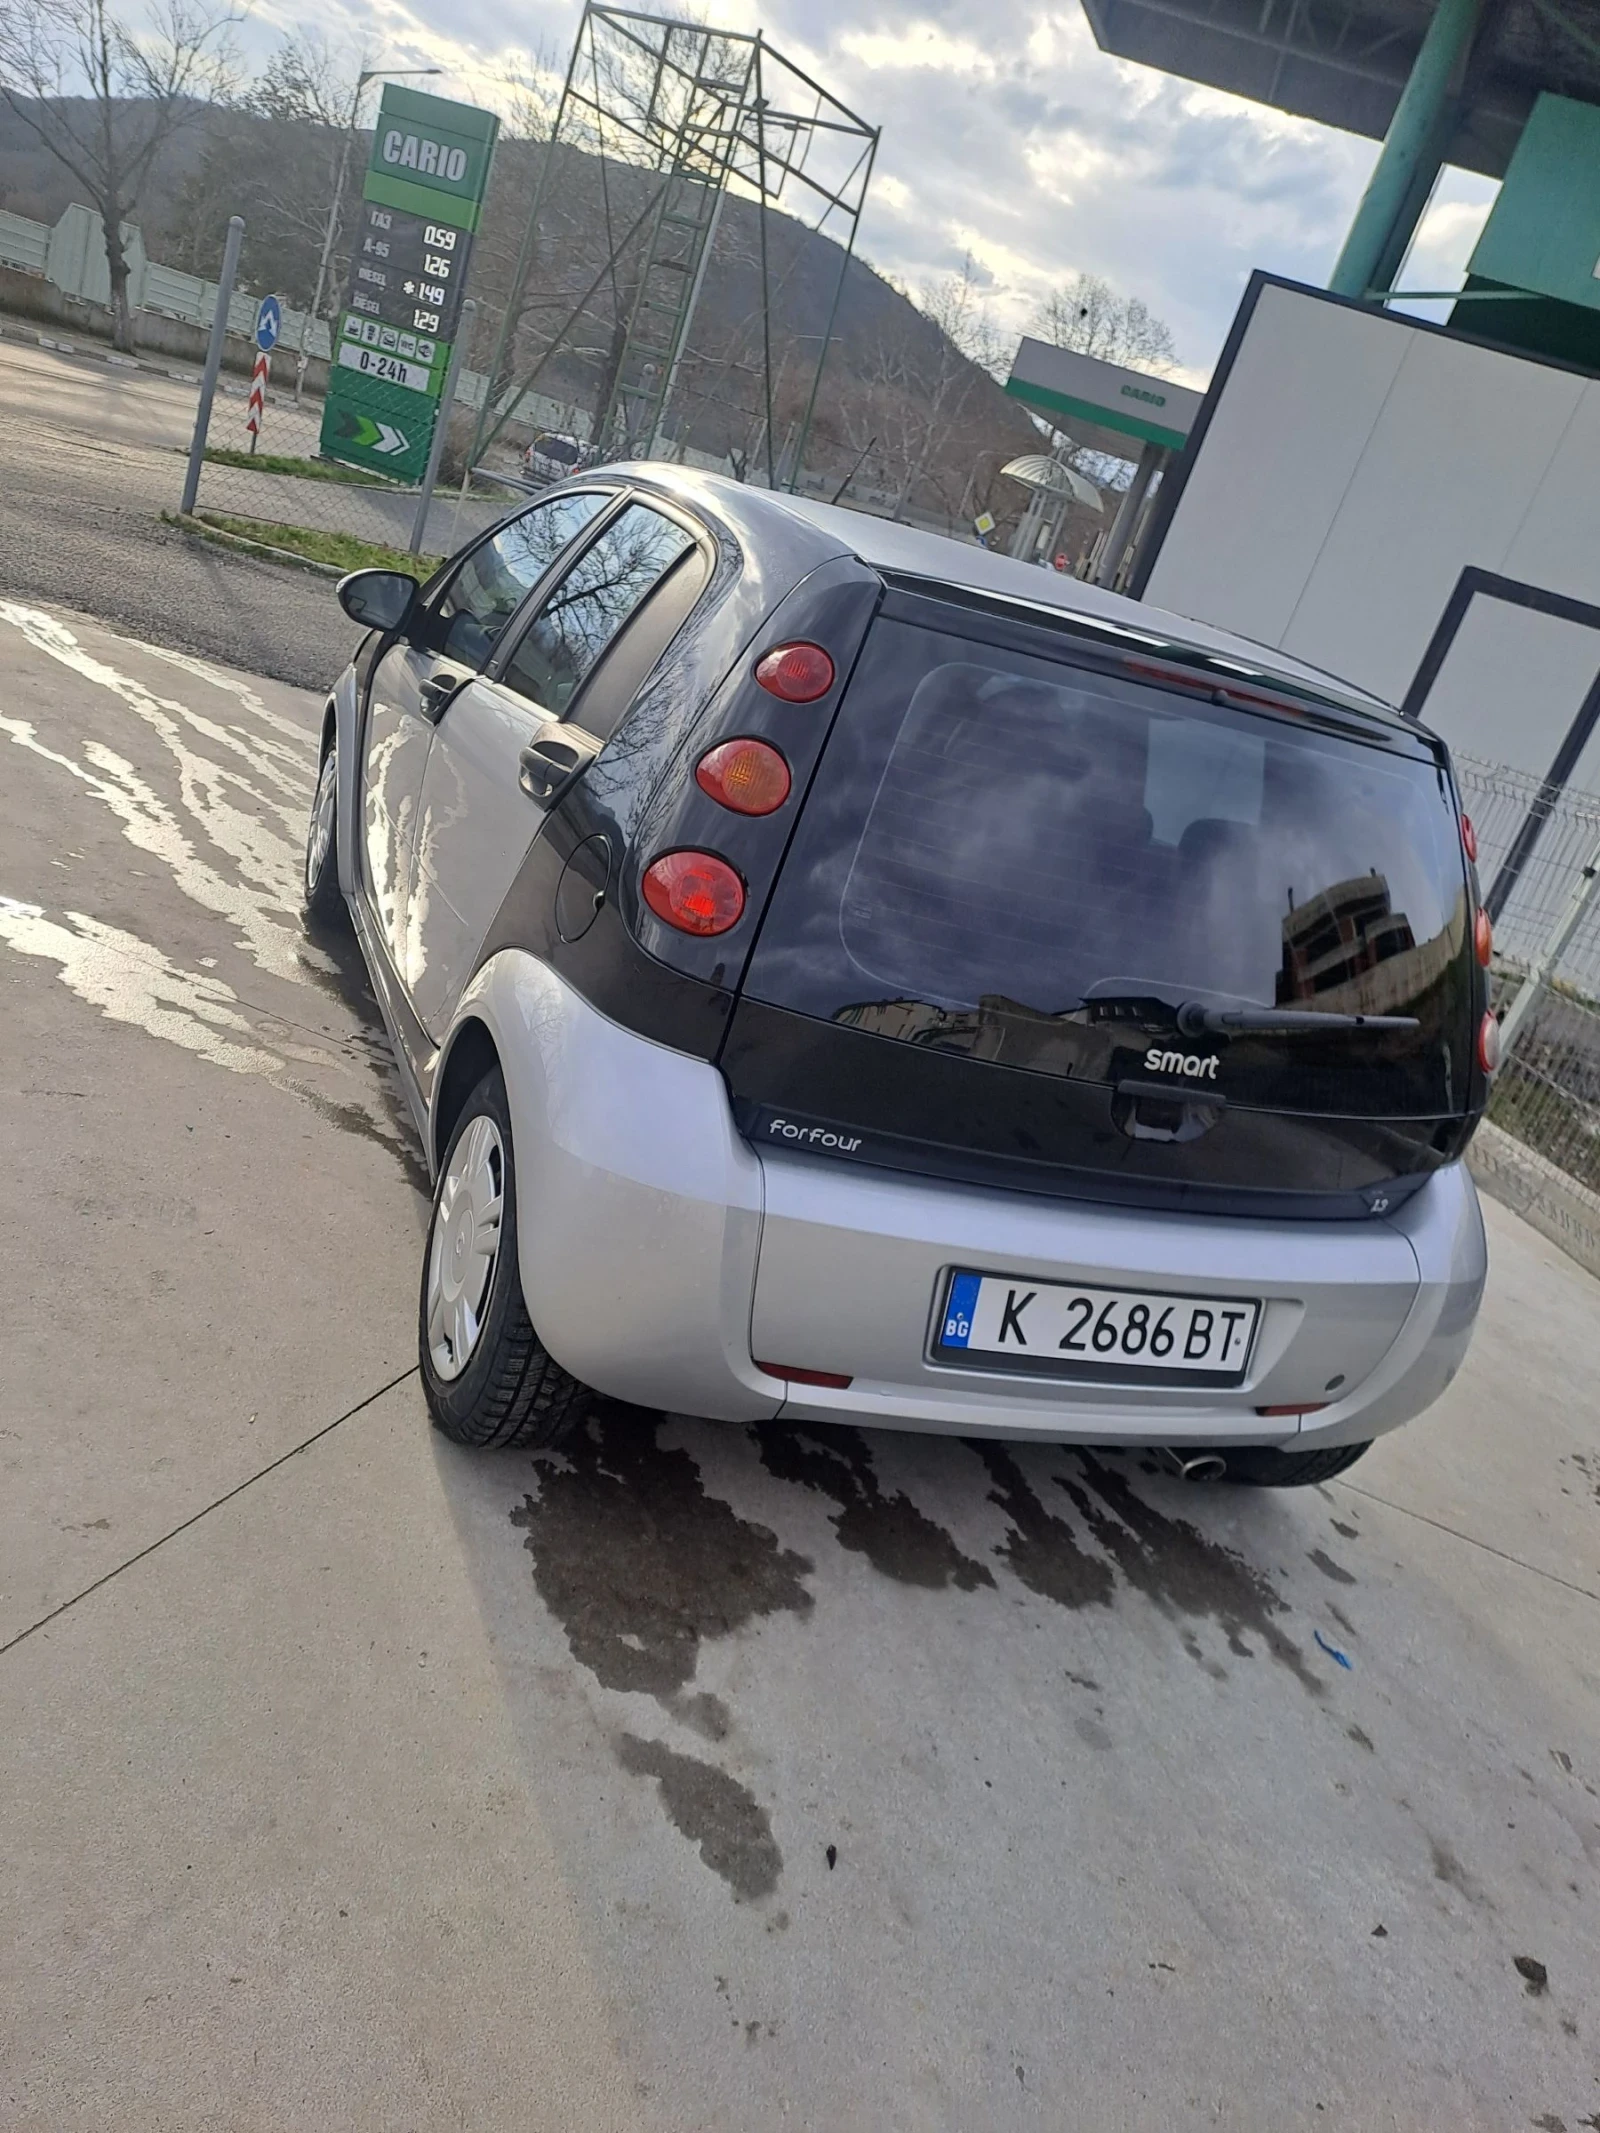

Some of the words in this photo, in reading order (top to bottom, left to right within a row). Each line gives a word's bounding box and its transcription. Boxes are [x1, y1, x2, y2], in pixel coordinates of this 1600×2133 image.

[382, 130, 467, 182] CARIO
[360, 351, 408, 383] 0-24h
[1144, 1049, 1220, 1079] smart
[770, 1119, 862, 1152] forfour
[945, 1319, 969, 1338] BG
[998, 1289, 1038, 1345] K
